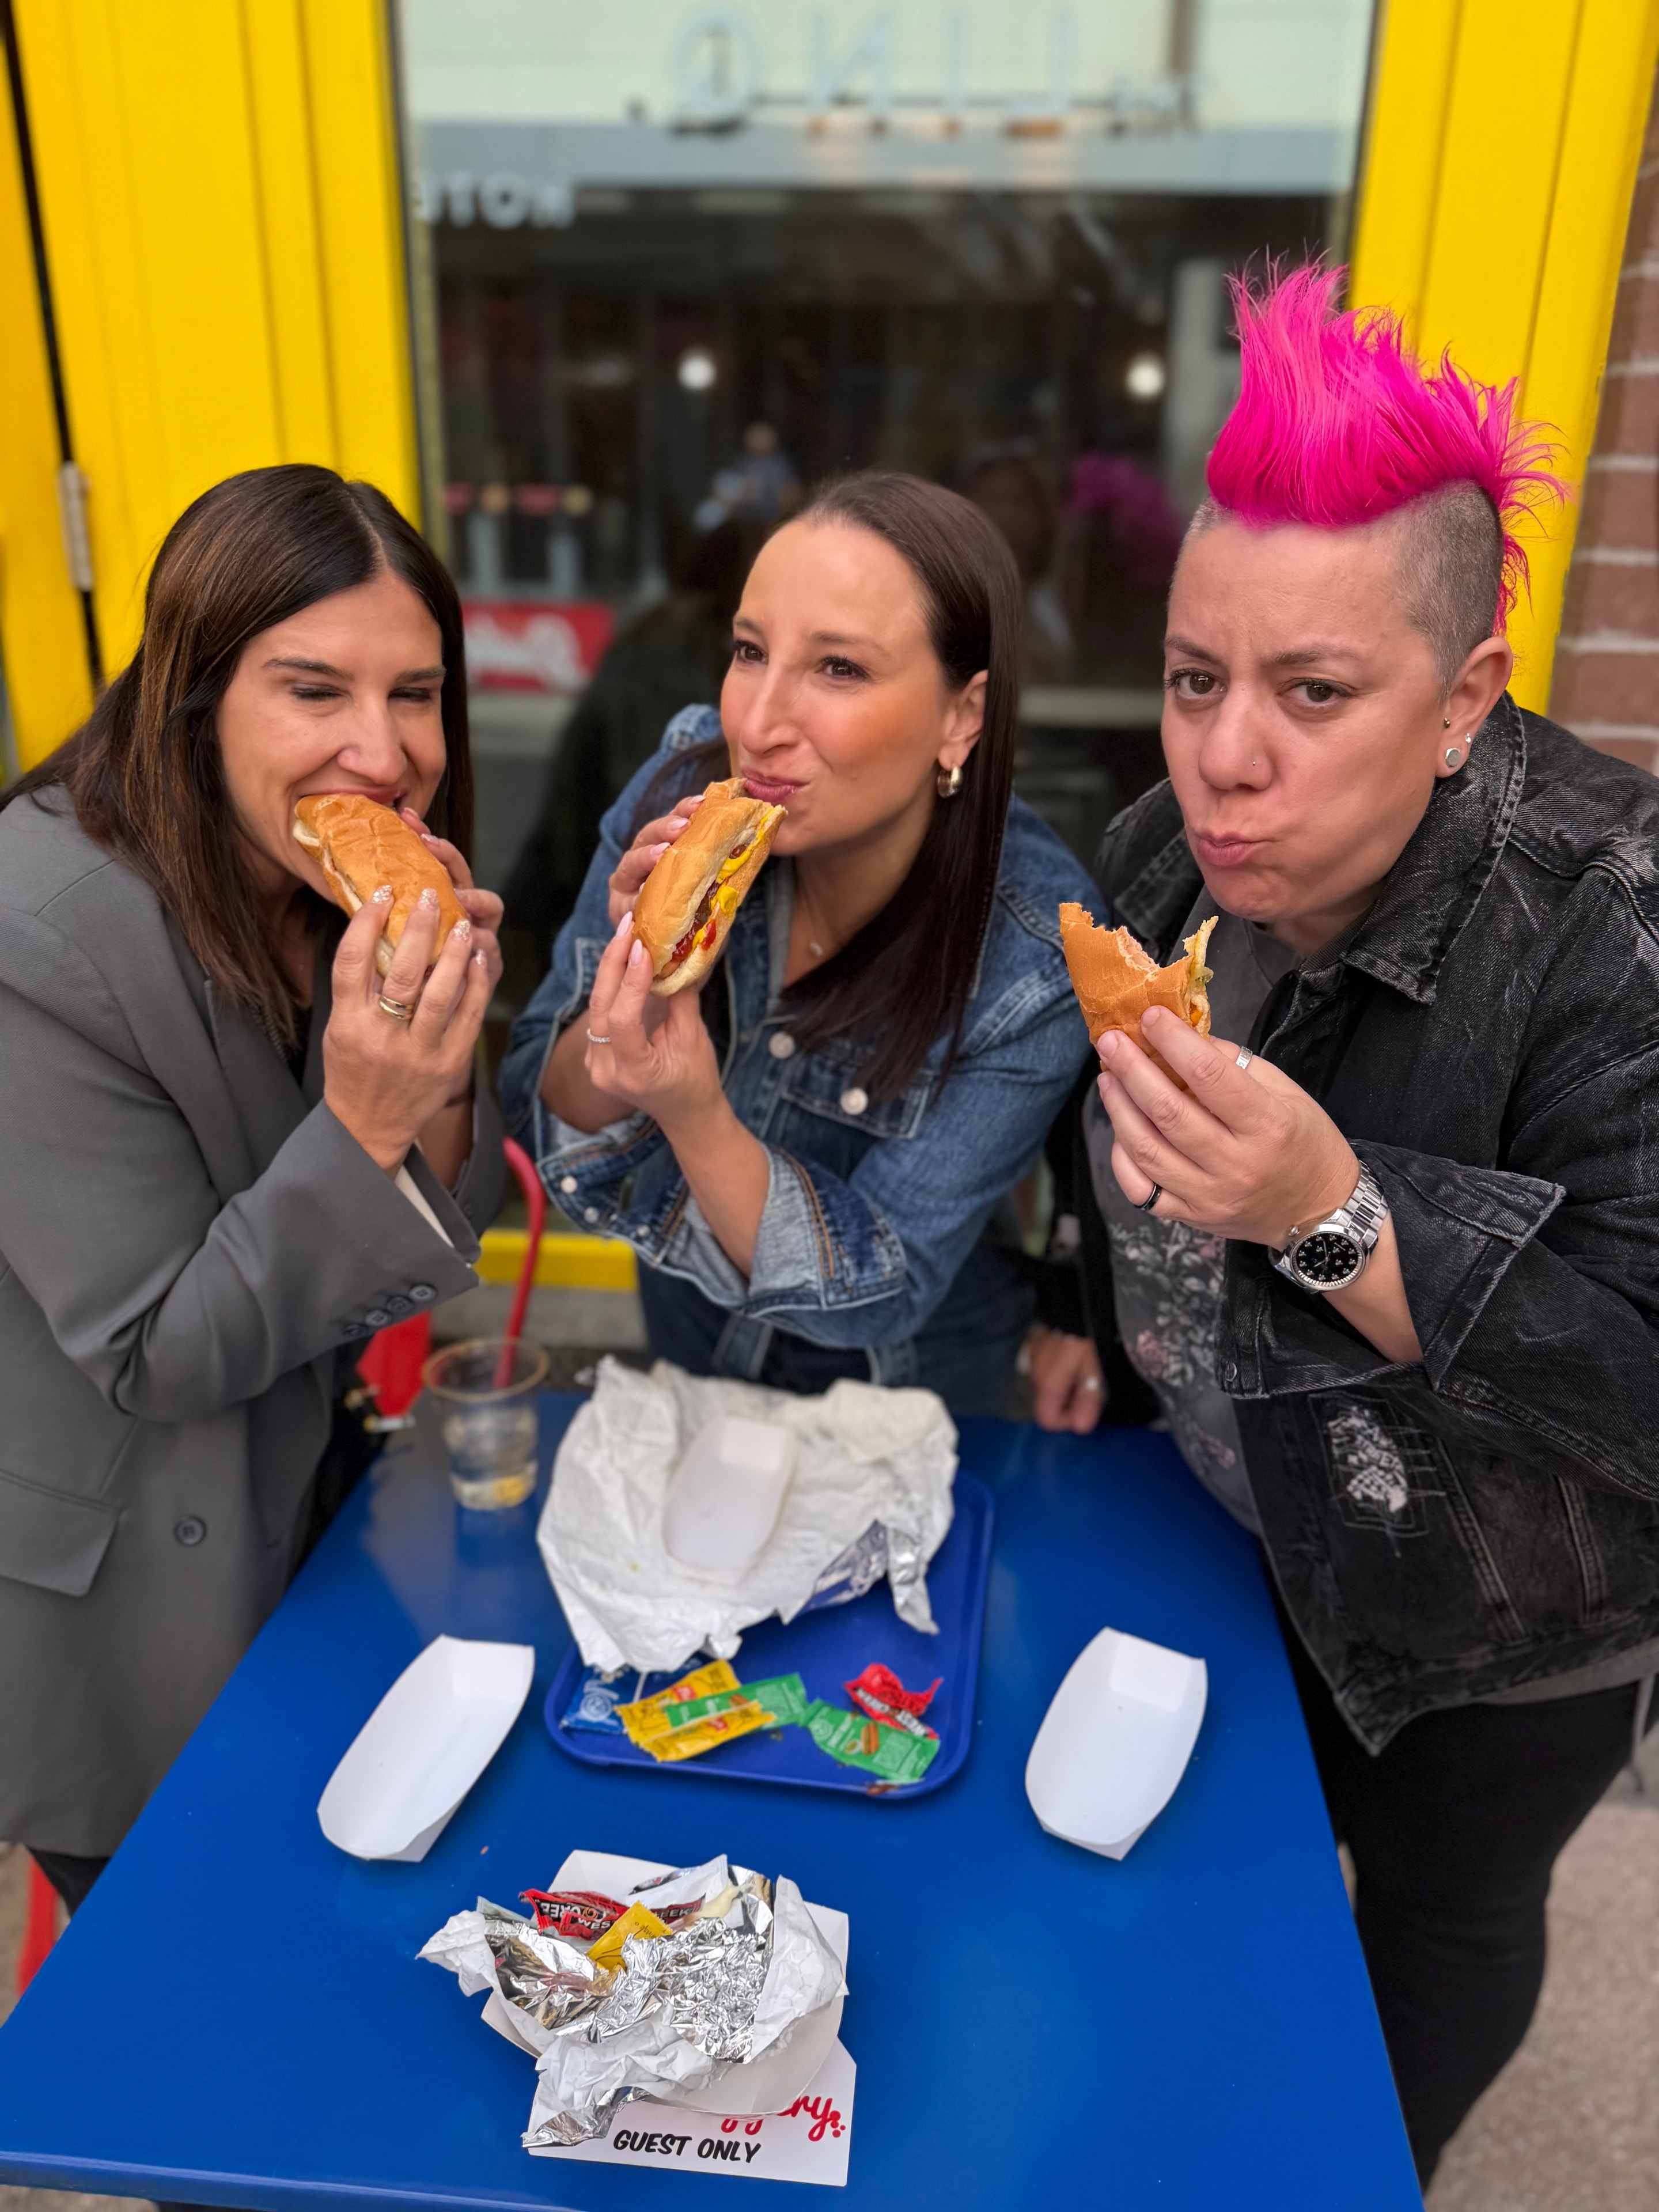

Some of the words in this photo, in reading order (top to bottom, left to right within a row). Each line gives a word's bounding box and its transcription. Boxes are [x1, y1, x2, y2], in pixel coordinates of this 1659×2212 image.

[578, 1916, 611, 1930] WES
[613, 2129, 692, 2156] GUEST
[696, 2138, 762, 2163] ONLY
